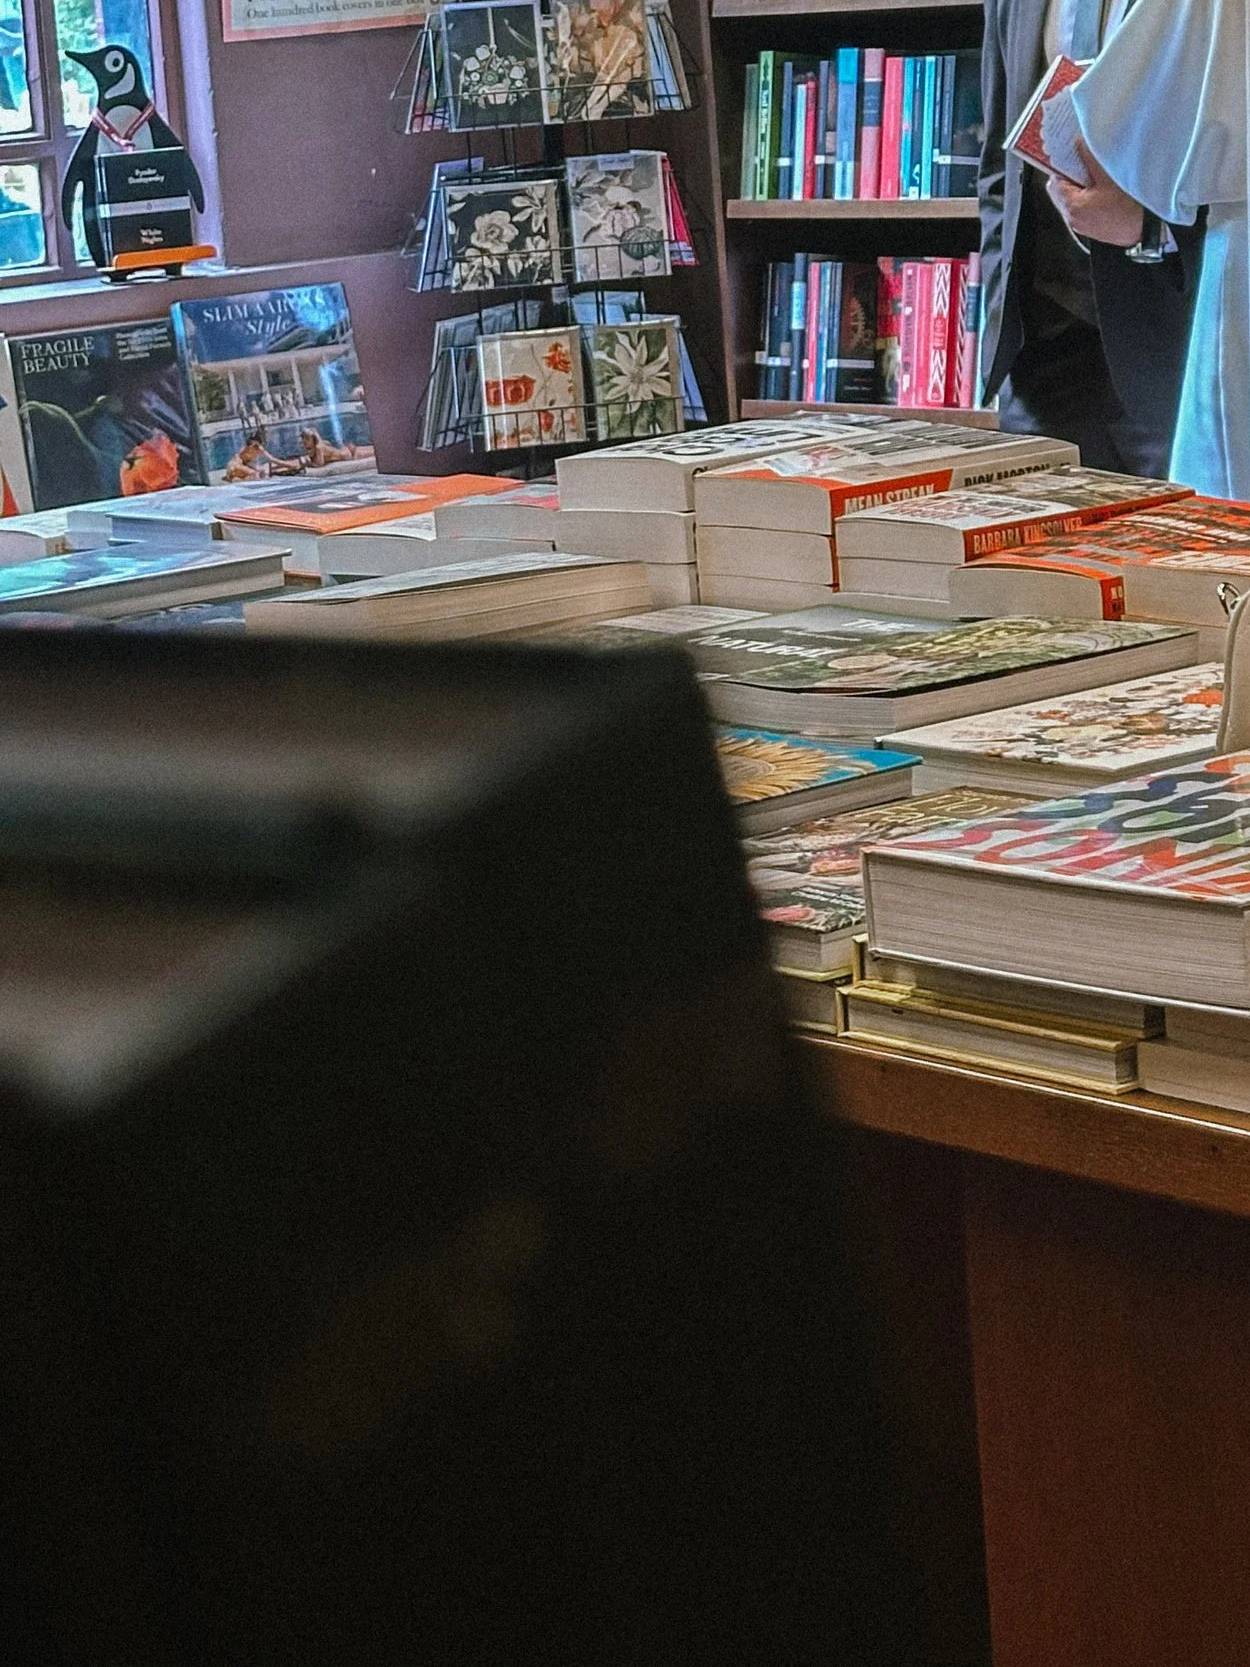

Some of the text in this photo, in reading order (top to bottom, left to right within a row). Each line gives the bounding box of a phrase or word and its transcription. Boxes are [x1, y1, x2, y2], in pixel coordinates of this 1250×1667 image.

[247, 7, 268, 20] One
[271, 3, 314, 18] hundred
[315, 0, 341, 14] book
[202, 302, 248, 323] SLIM
[246, 314, 291, 340] Style
[20, 335, 94, 361] FRAGILE
[23, 351, 91, 376] BEAUTY
[844, 491, 884, 515] MEAN
[973, 525, 1022, 554] BARBARA
[1022, 516, 1083, 544] KINGSOLVER
[841, 618, 915, 632] THE
